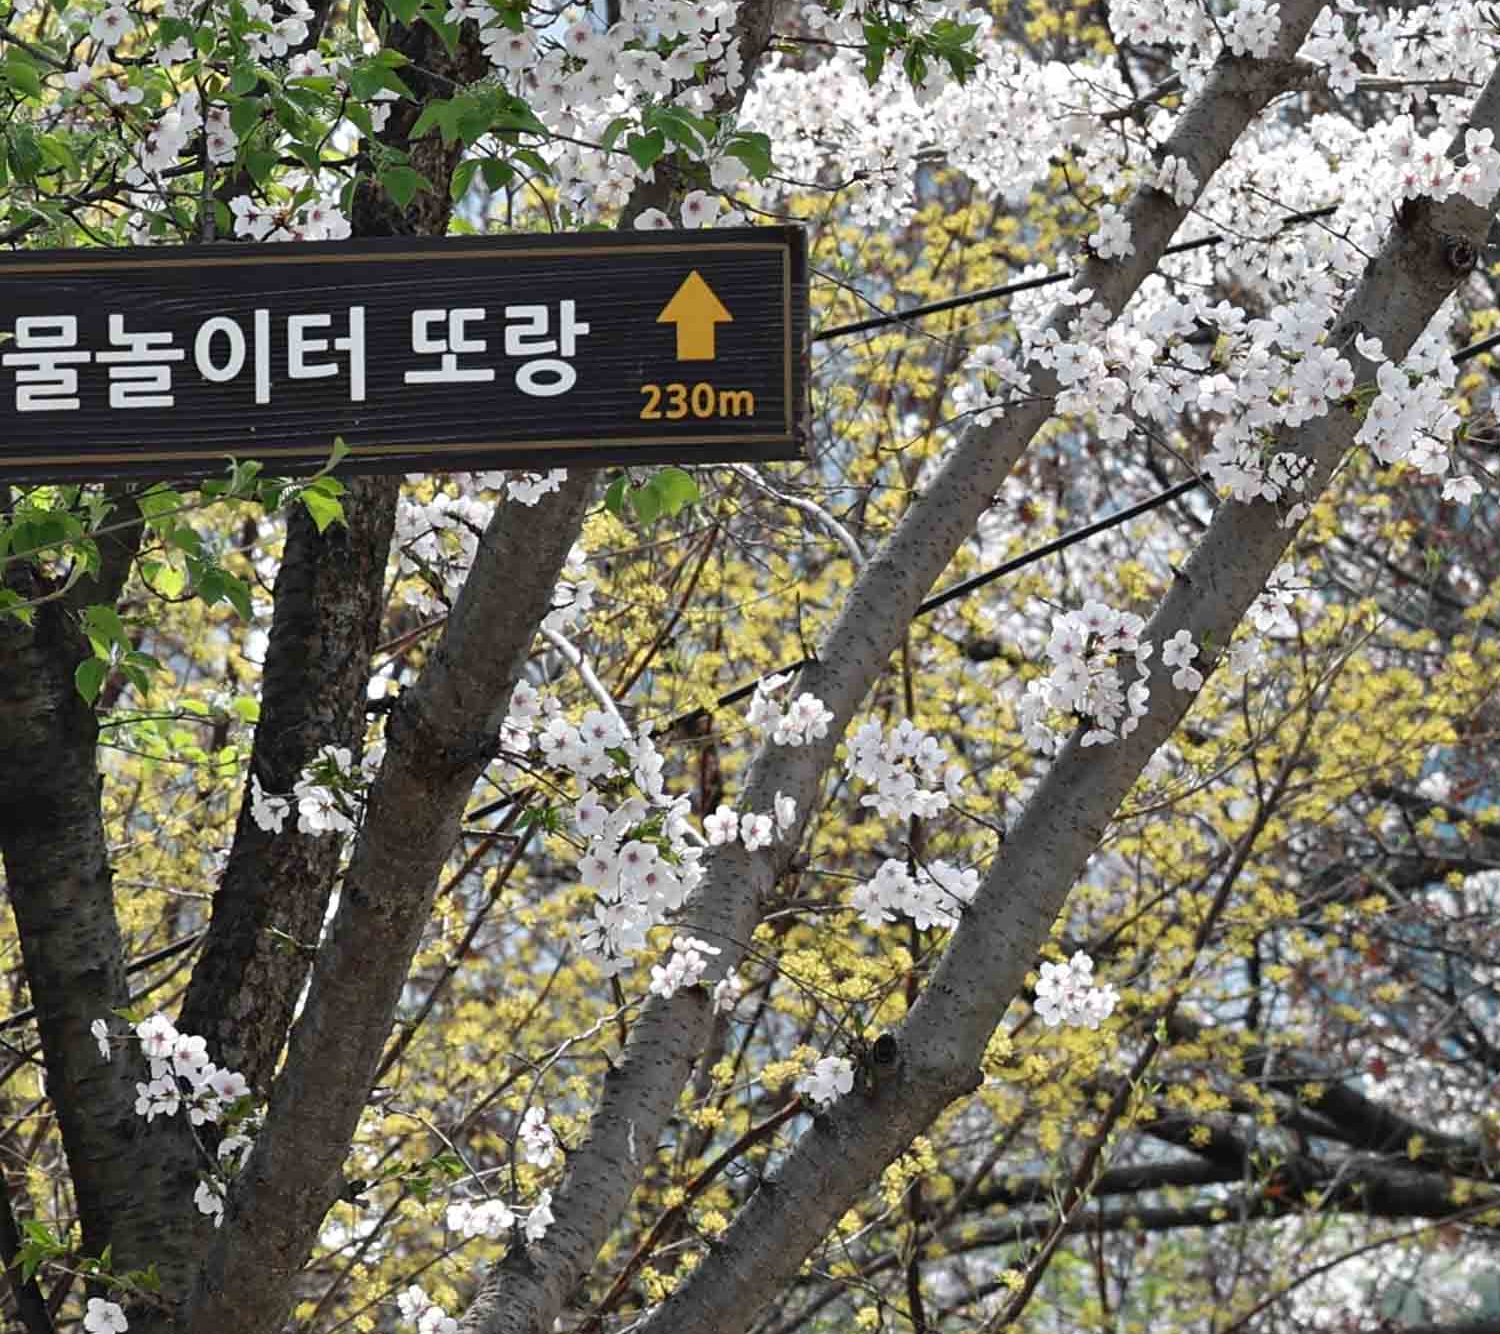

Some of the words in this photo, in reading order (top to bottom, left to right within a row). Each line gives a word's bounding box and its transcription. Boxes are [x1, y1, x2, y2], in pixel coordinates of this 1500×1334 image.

[0, 306, 366, 412] 물놀이터
[403, 299, 590, 397] 또랑
[640, 382, 755, 420] 230m
